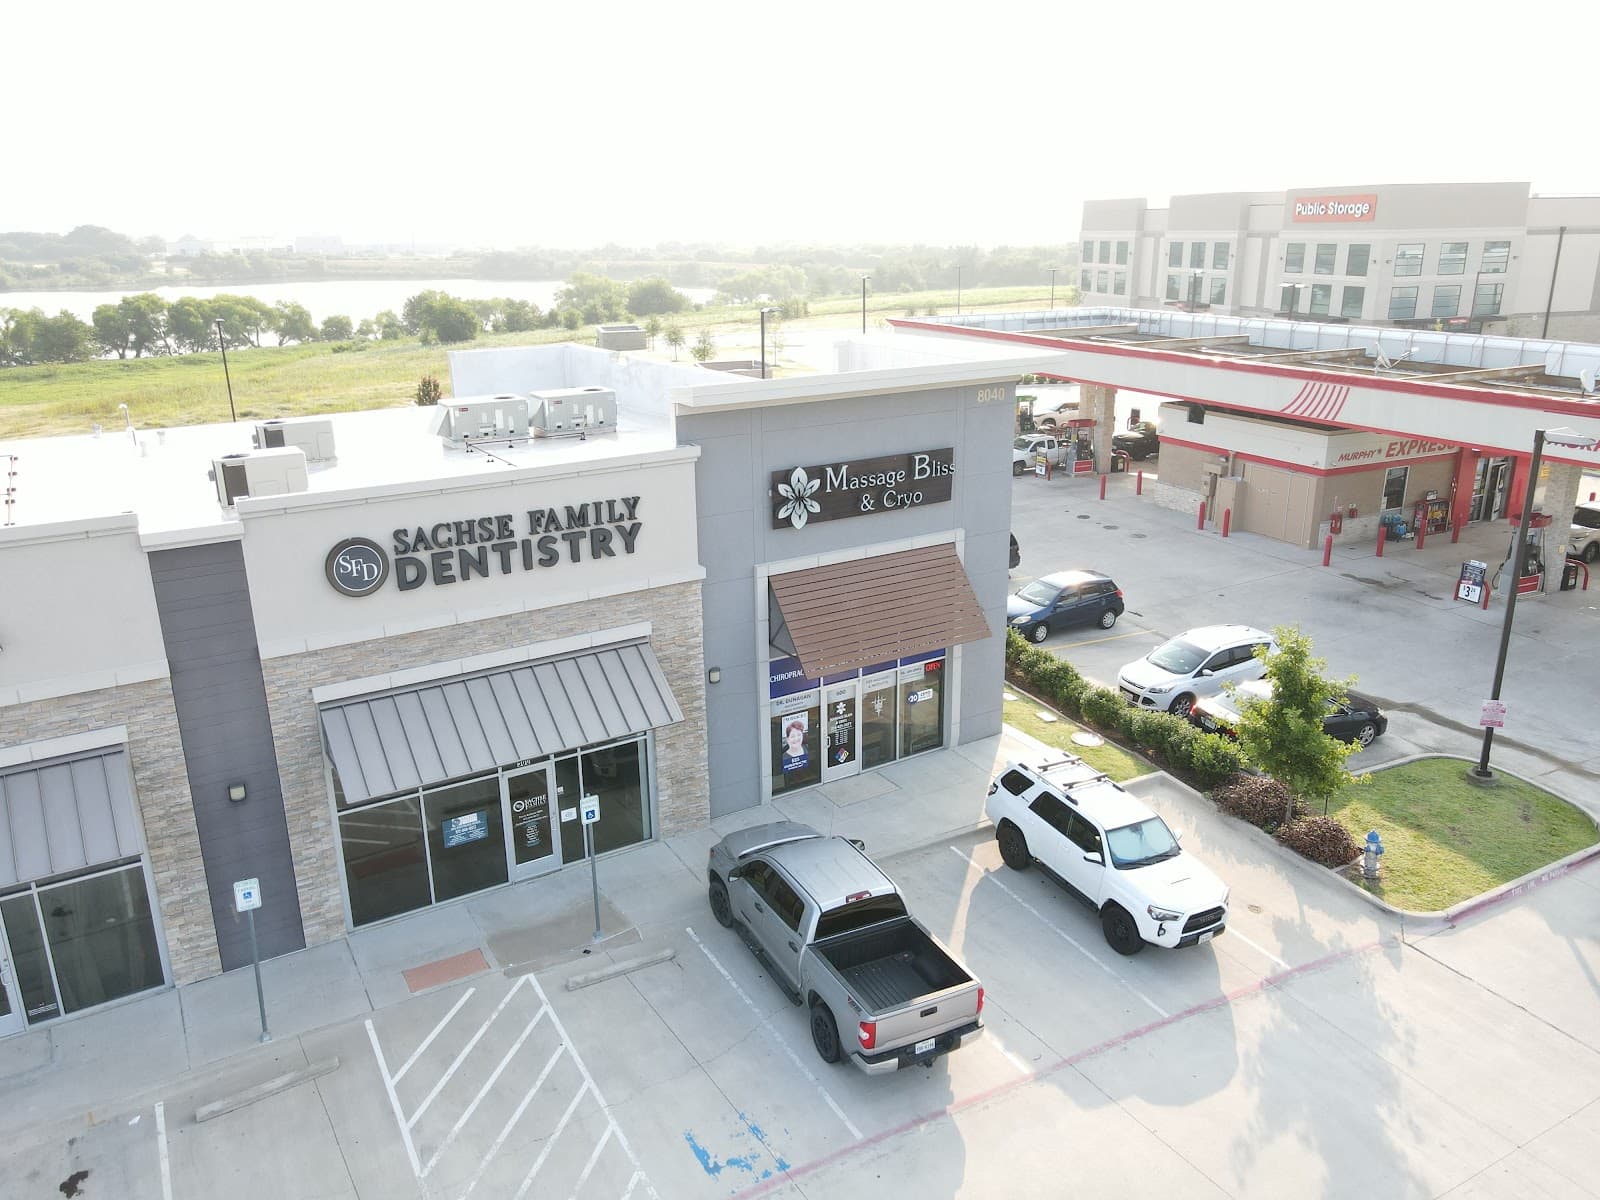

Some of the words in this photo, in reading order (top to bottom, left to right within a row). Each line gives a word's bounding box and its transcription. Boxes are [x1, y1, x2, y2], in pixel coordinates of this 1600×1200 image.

[1295, 203, 1326, 216] Public
[1327, 201, 1370, 218] Storage
[977, 387, 1005, 402] 8040
[1338, 449, 1376, 462] MURPHY
[825, 465, 906, 493] Massage
[912, 454, 956, 480] Bliss
[860, 494, 875, 512] &
[883, 490, 923, 509] Cryo
[393, 514, 515, 555] SACHSE
[527, 496, 641, 535] FAMILY
[394, 522, 643, 591] DENTISTRY
[339, 555, 379, 582] SFD
[925, 661, 942, 672] OPEN
